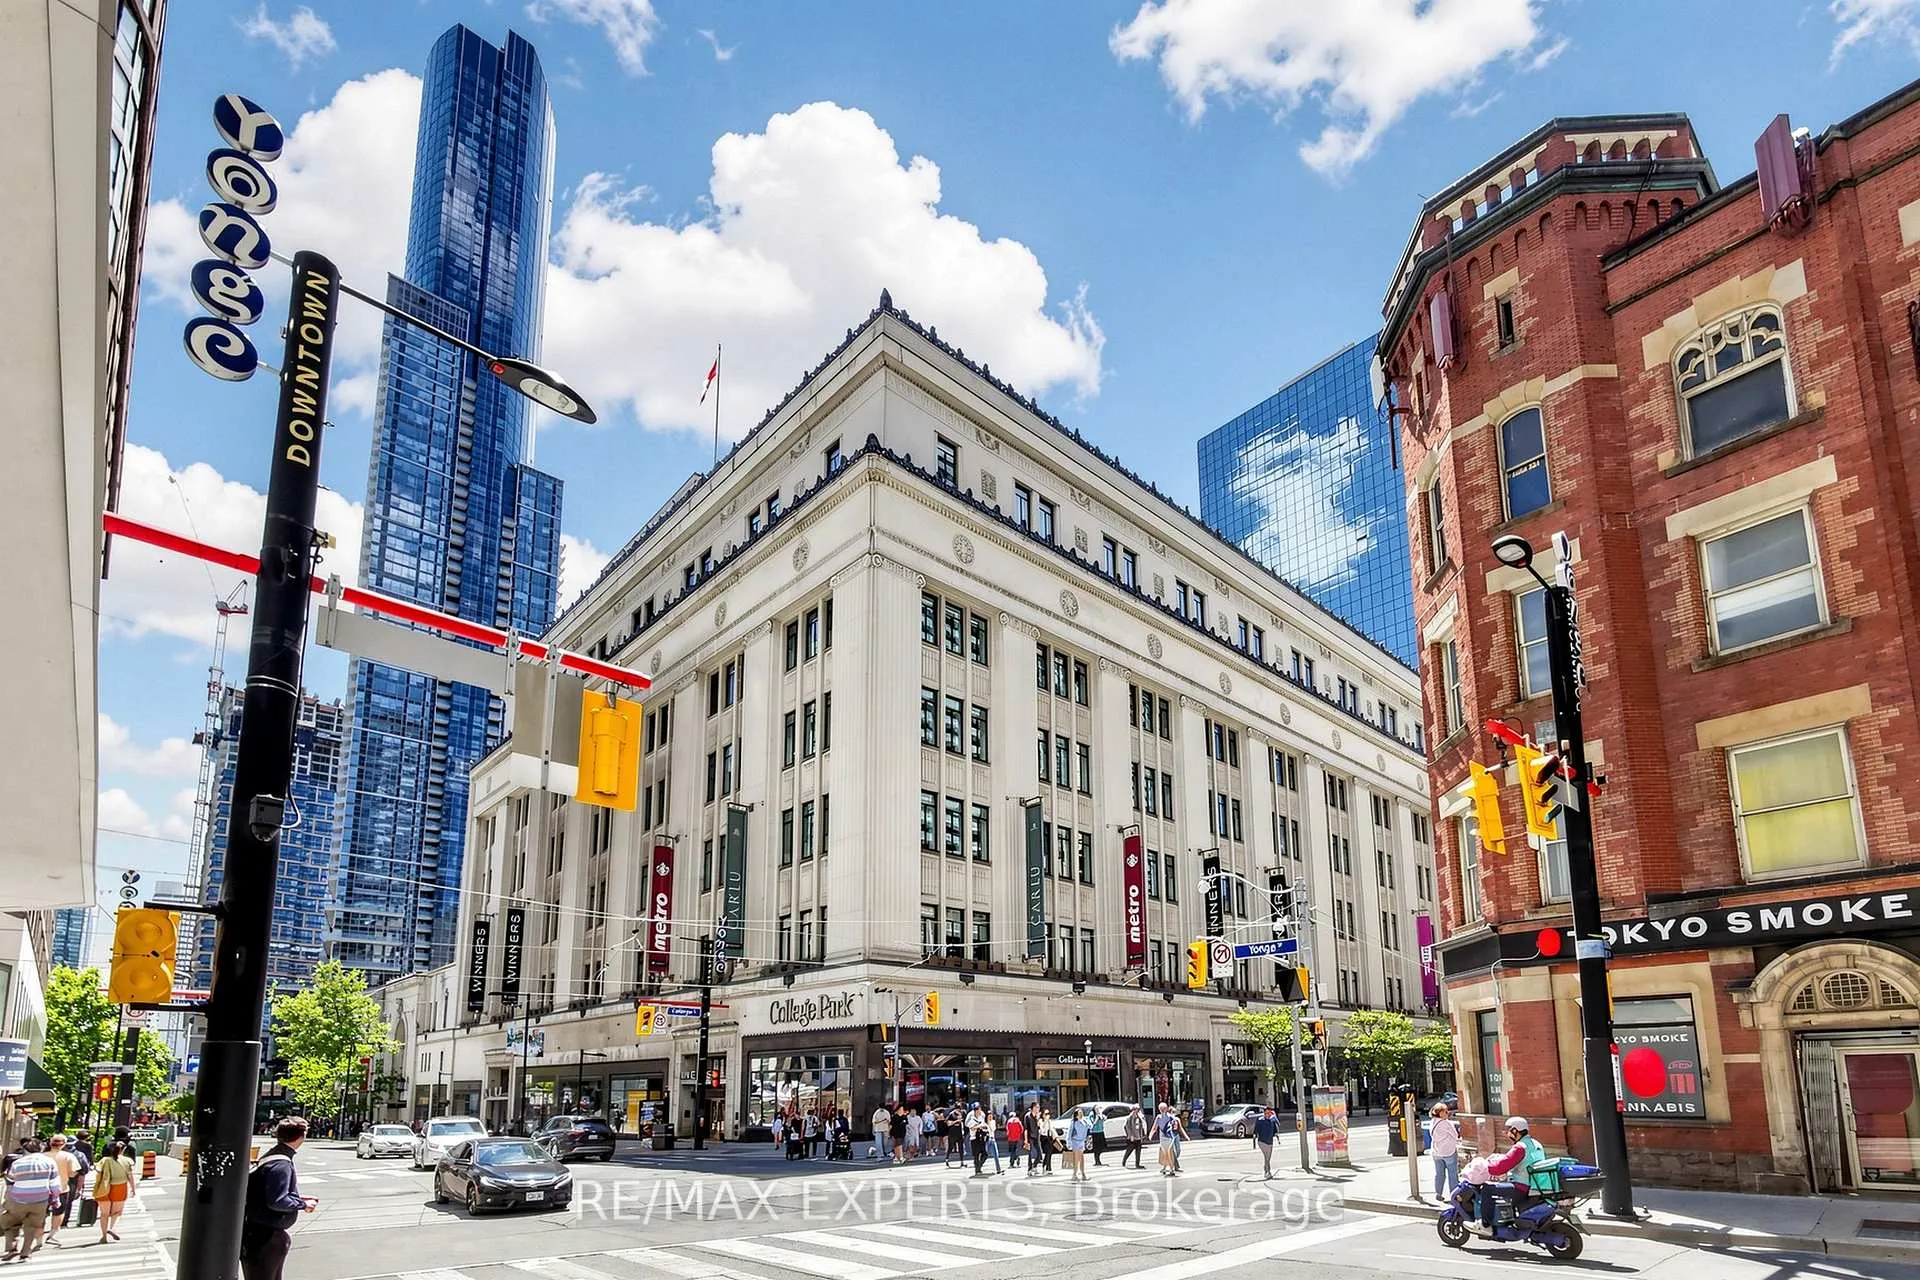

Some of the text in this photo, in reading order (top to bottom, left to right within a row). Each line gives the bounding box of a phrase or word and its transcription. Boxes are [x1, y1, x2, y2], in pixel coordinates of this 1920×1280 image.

[286, 270, 330, 467] DOWNTOWN
[653, 892, 668, 951] metro
[1029, 866, 1041, 927] CARLU
[1127, 884, 1141, 944] metro
[1207, 866, 1219, 934] INNERS
[1727, 893, 1913, 934] SMOKE
[507, 914, 521, 984] WINNERS
[769, 991, 855, 1027] College Park
[1641, 1033, 1689, 1044] SMOKE
